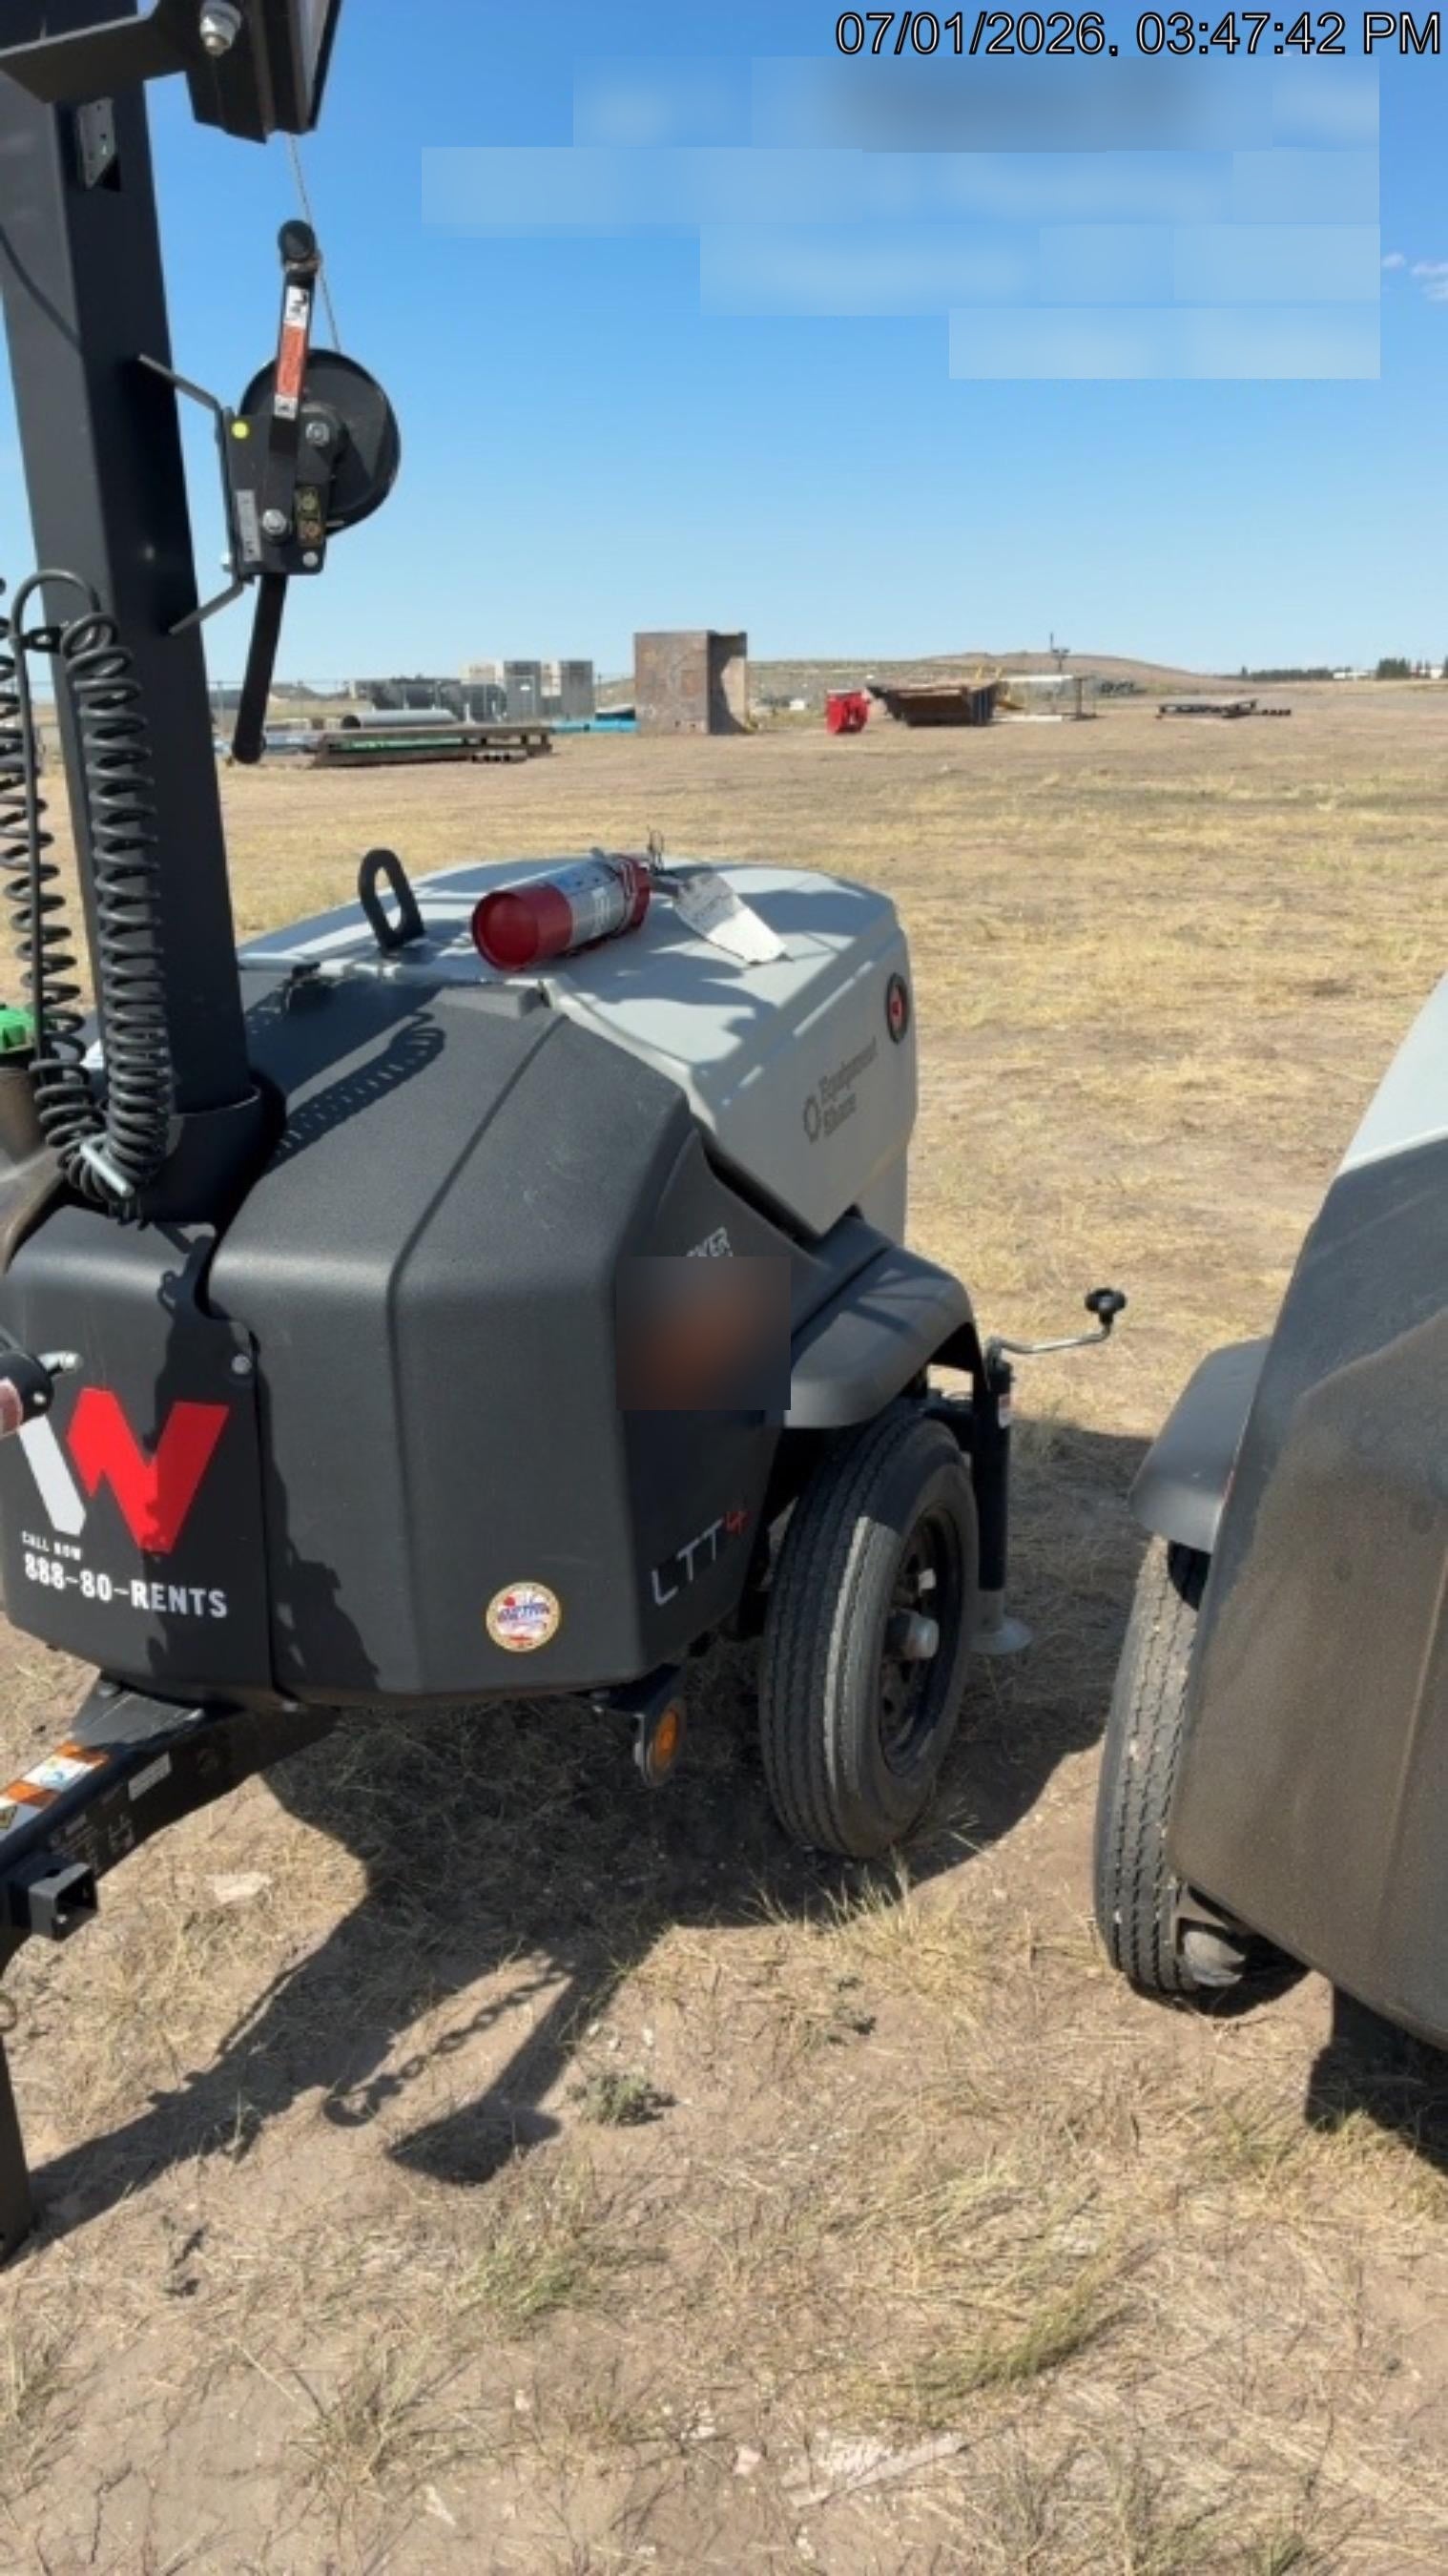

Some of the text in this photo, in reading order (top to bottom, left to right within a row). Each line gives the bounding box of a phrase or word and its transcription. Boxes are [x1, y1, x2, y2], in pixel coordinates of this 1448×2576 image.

[22, 1530, 82, 1561] CALL NOW
[24, 1551, 228, 1618] 888-80-RENTS
